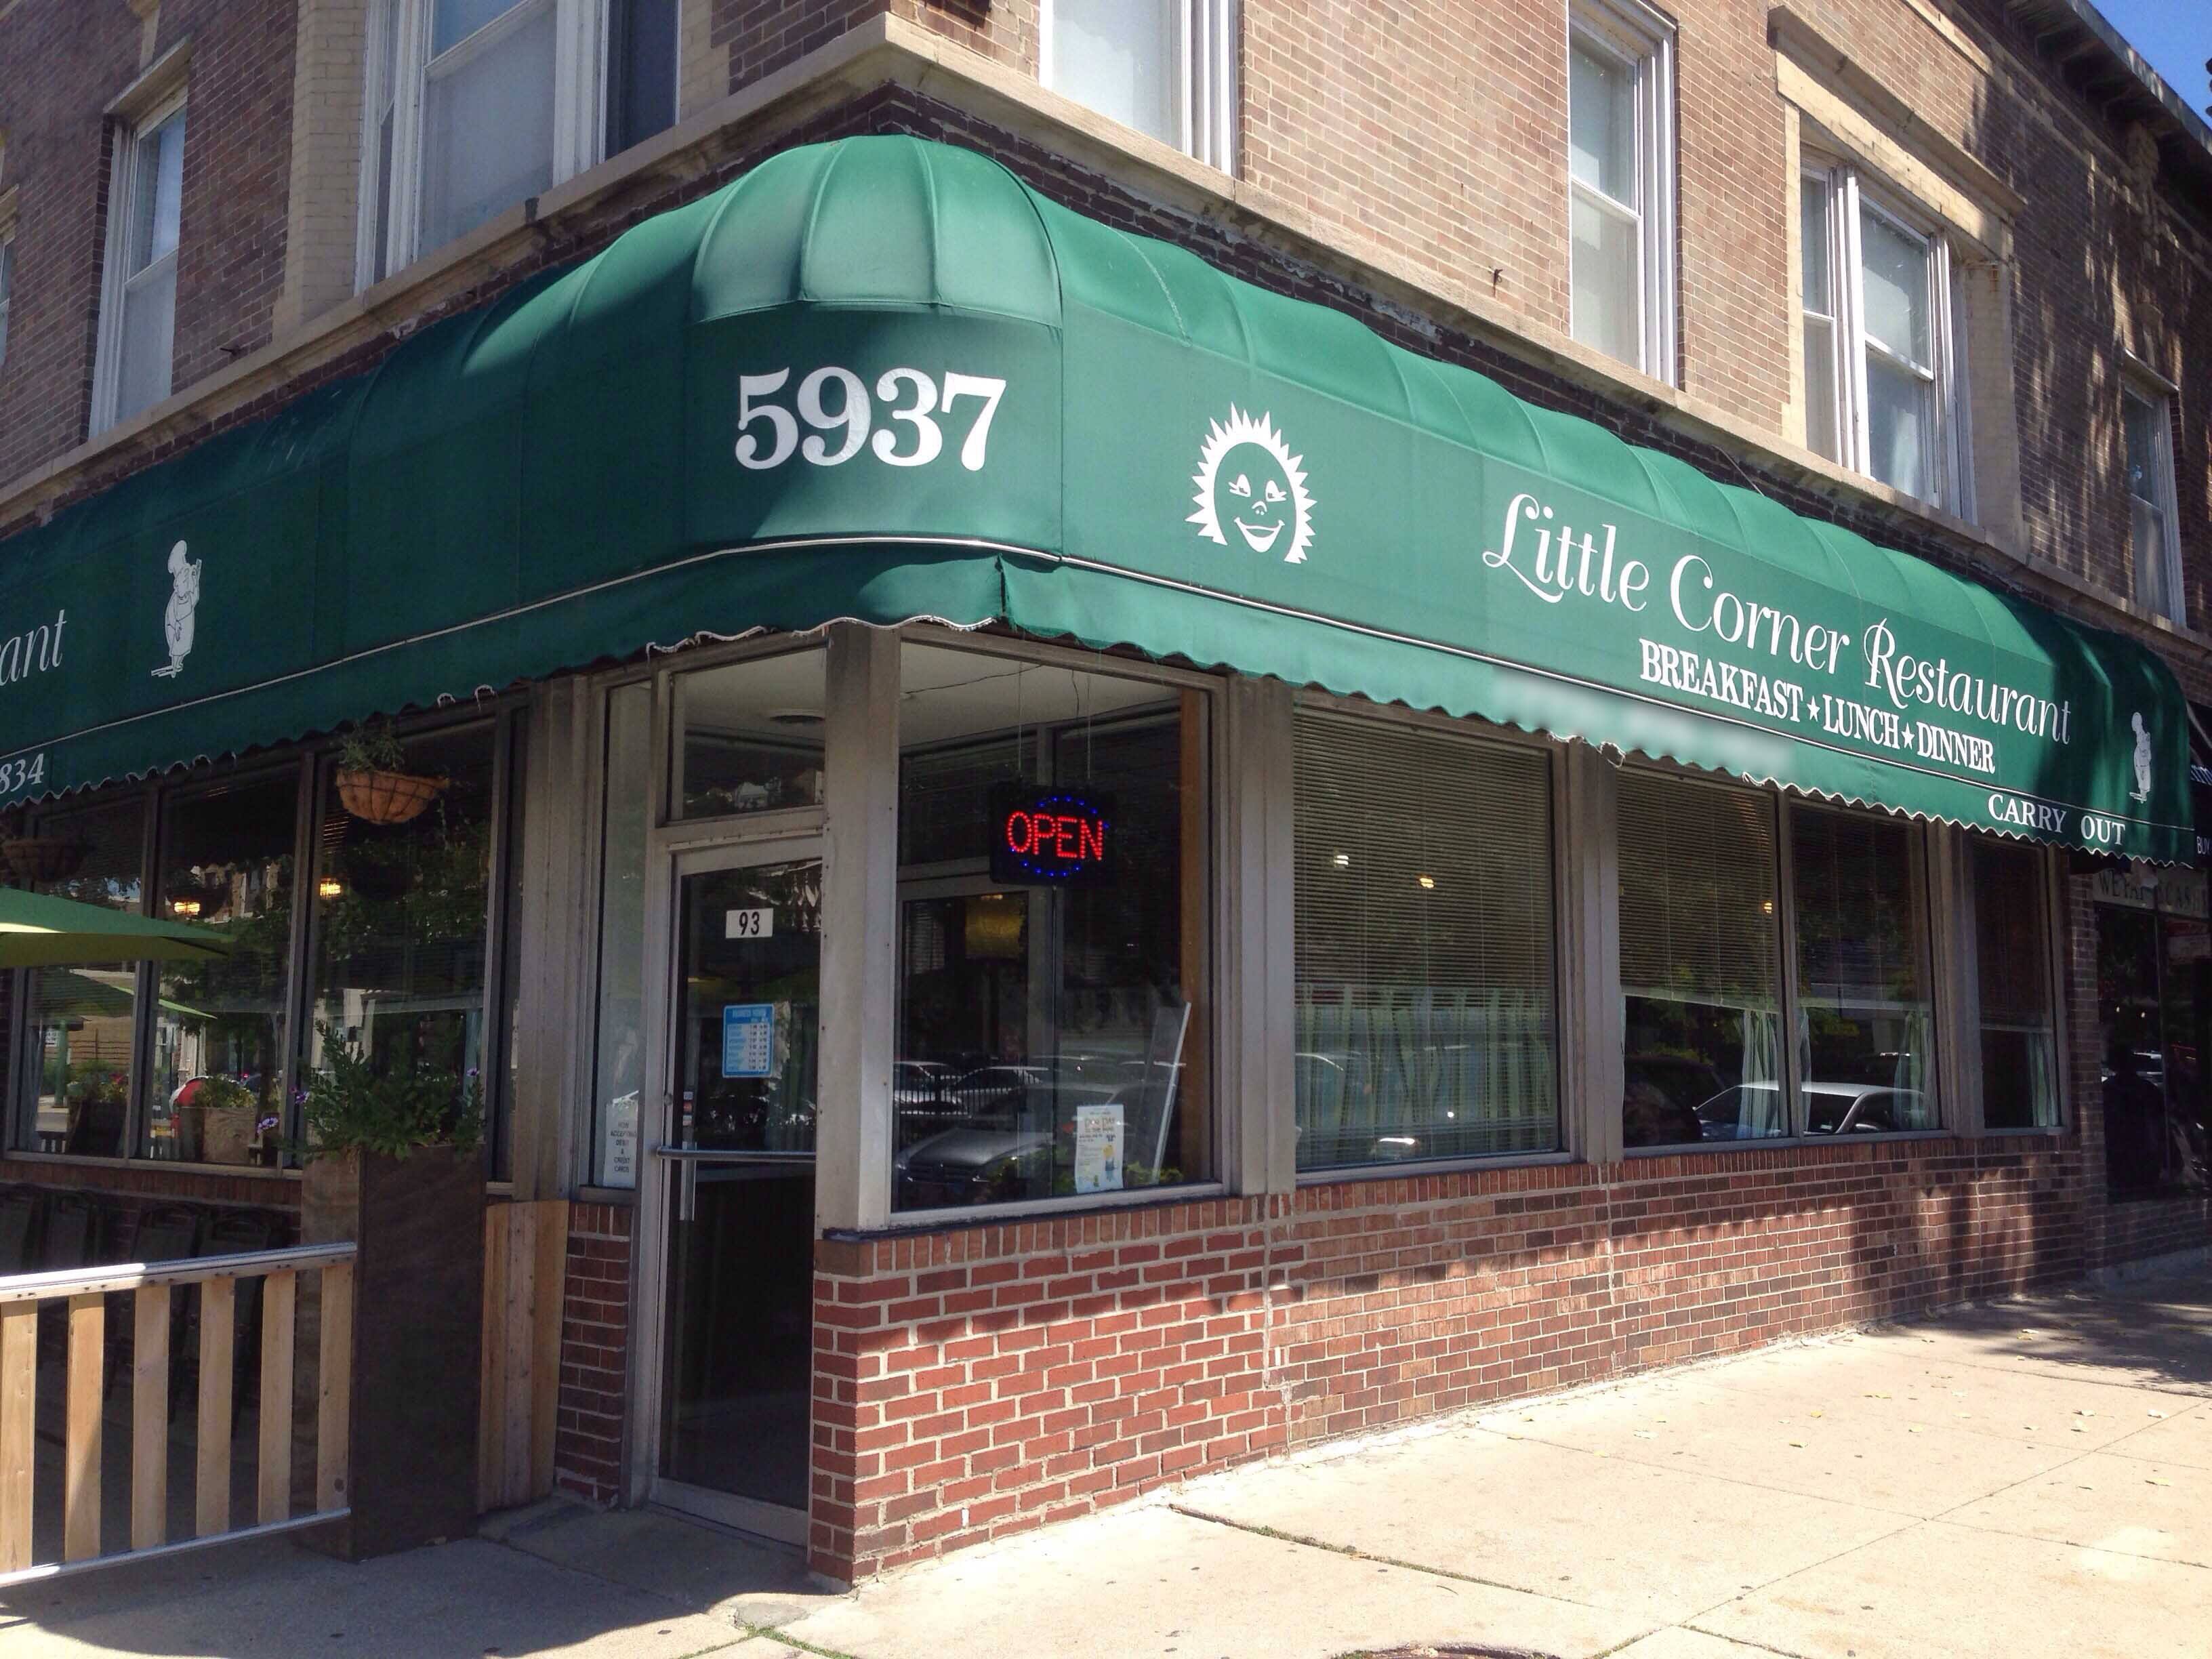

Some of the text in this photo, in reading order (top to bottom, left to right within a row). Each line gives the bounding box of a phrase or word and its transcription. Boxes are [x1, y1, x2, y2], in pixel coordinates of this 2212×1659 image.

[735, 367, 1006, 471] 5937
[1482, 493, 1650, 612] Little
[1670, 554, 1850, 674] Corner
[1864, 617, 2071, 744] Restaurant
[1639, 638, 1803, 722] BREAKFAST
[1822, 694, 1900, 750] LUNCH
[1916, 721, 1996, 774] DINNER
[1006, 811, 1103, 861] OPEN
[1988, 793, 2126, 846] CARRY OUT
[738, 911, 760, 935] 93
